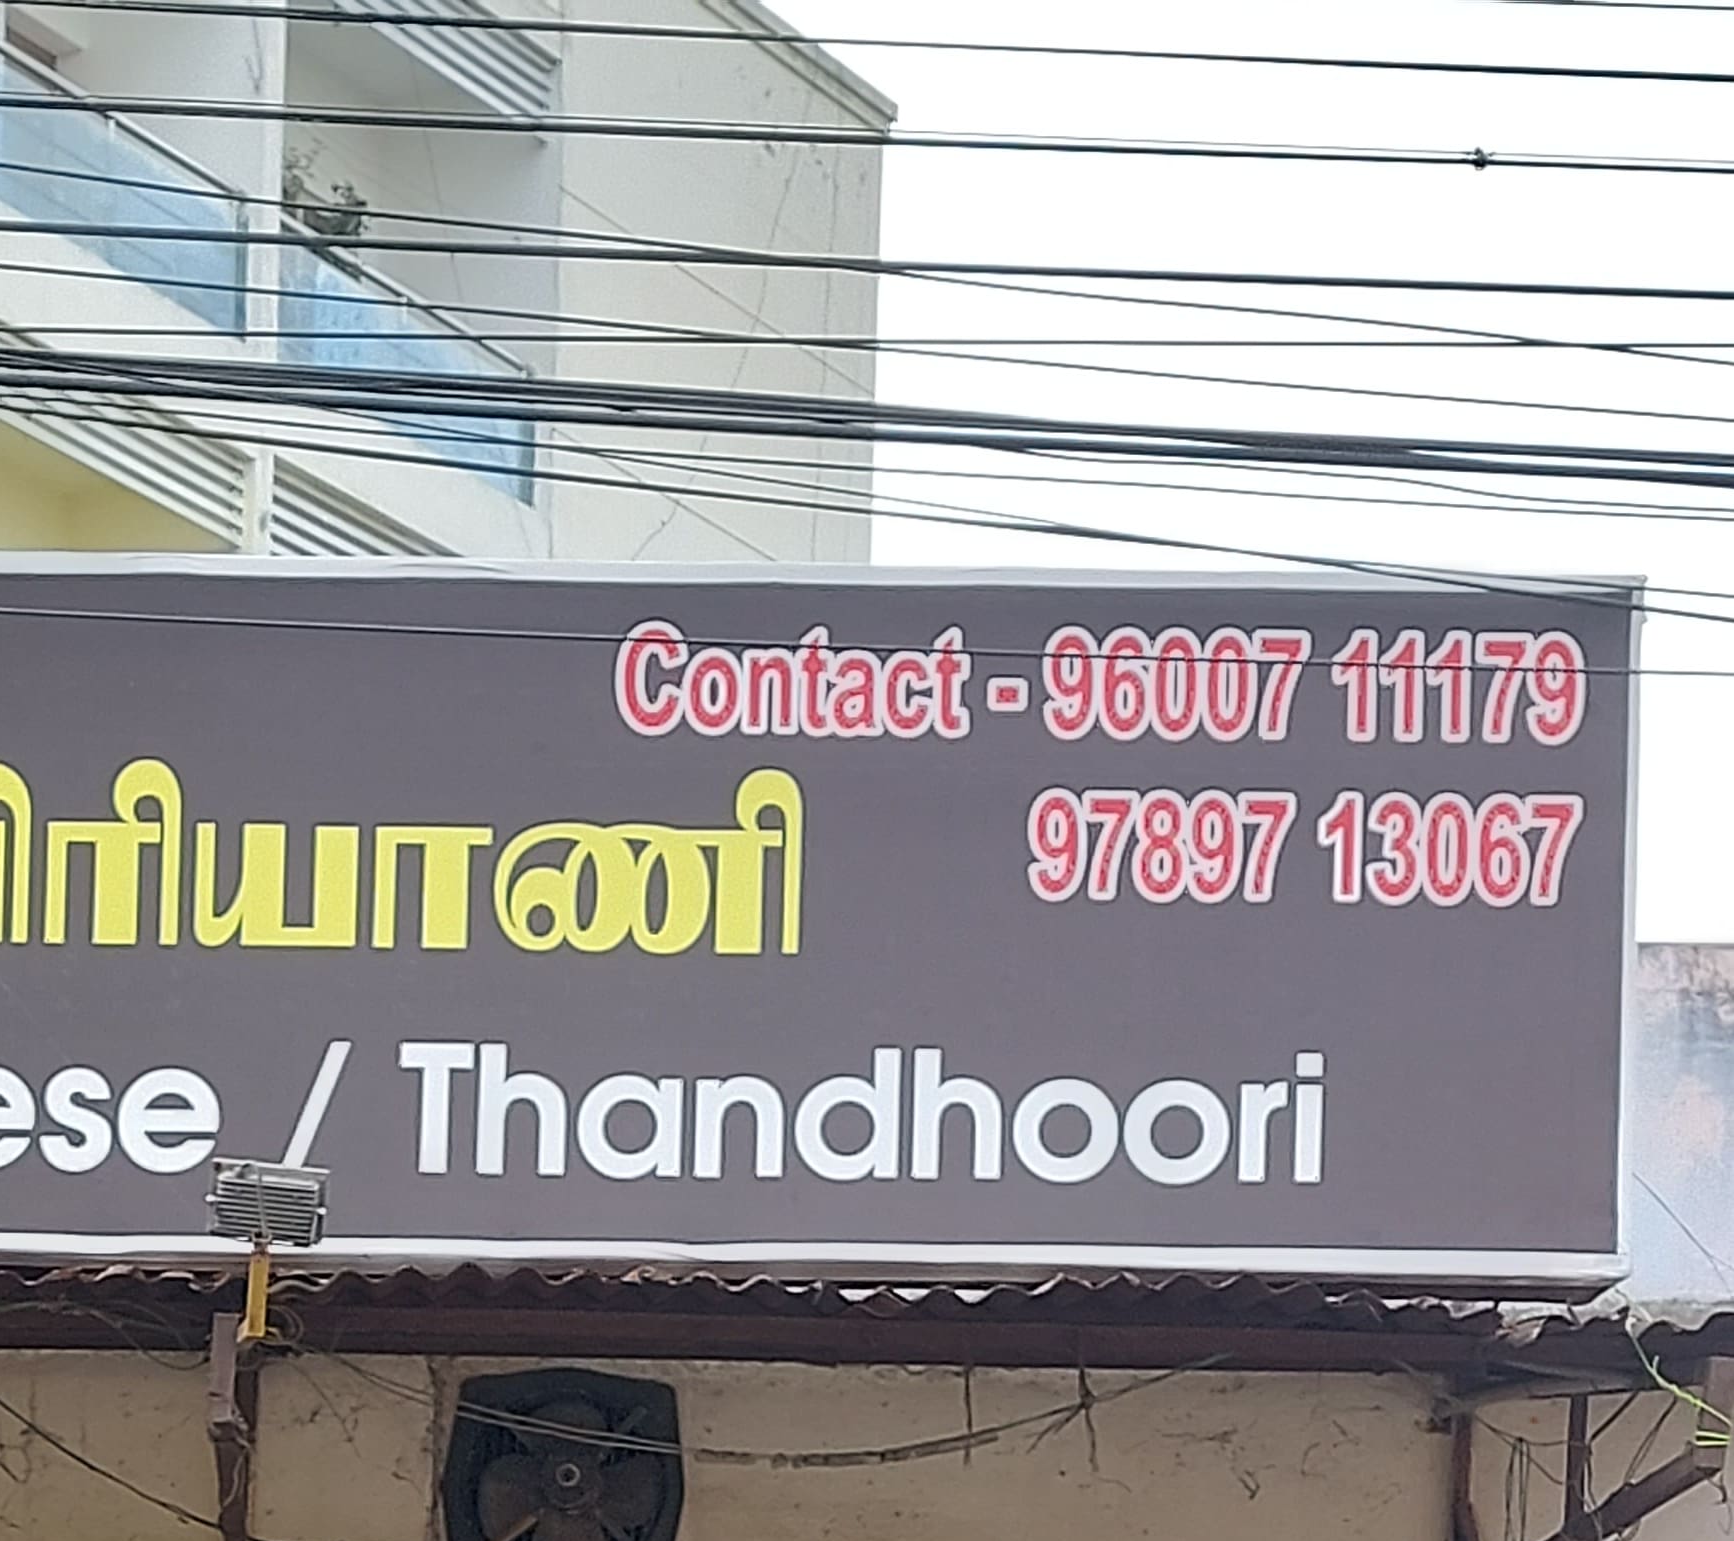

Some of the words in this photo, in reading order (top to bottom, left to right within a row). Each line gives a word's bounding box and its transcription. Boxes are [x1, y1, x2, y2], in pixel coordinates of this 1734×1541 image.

[616, 620, 972, 738] Contact
[1042, 625, 1312, 741] 96007
[1330, 626, 1586, 745] 11179
[1028, 787, 1298, 904] 97897
[1318, 789, 1583, 907] 13067
[399, 1040, 1324, 1186] Thandhoori
